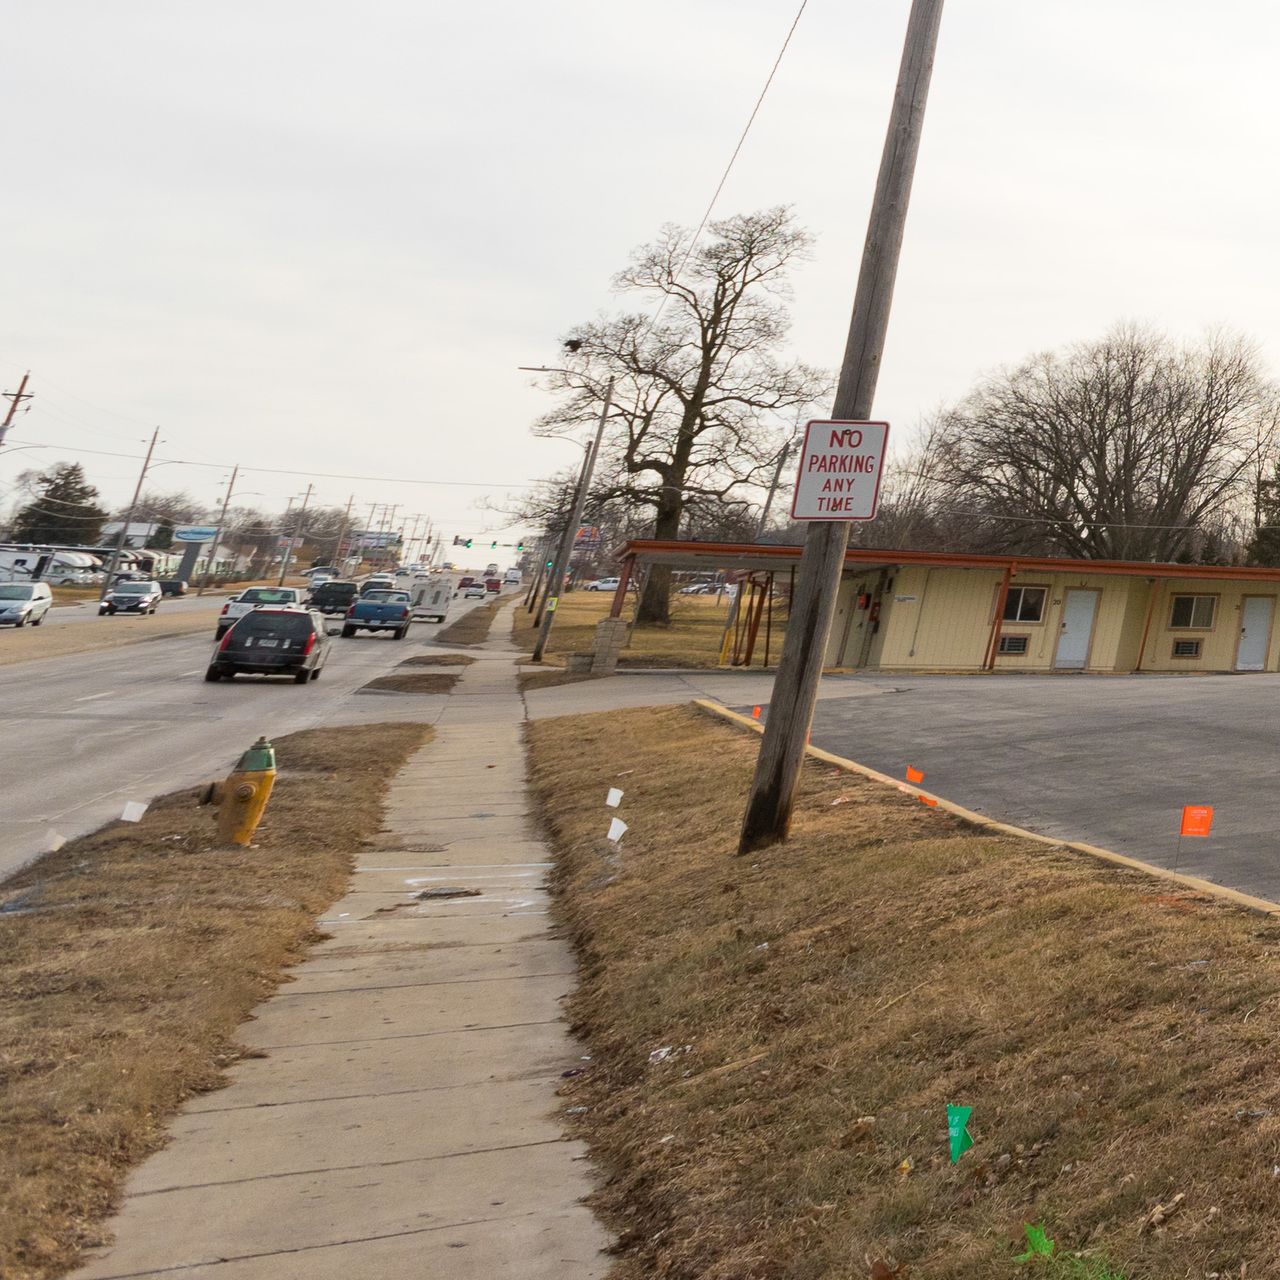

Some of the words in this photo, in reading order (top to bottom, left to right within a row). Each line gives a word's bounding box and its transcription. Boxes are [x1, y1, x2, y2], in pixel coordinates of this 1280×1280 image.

[829, 430, 863, 448] NO
[808, 455, 875, 473] PARKING
[822, 478, 855, 492] ANY
[817, 497, 854, 511] TIME
